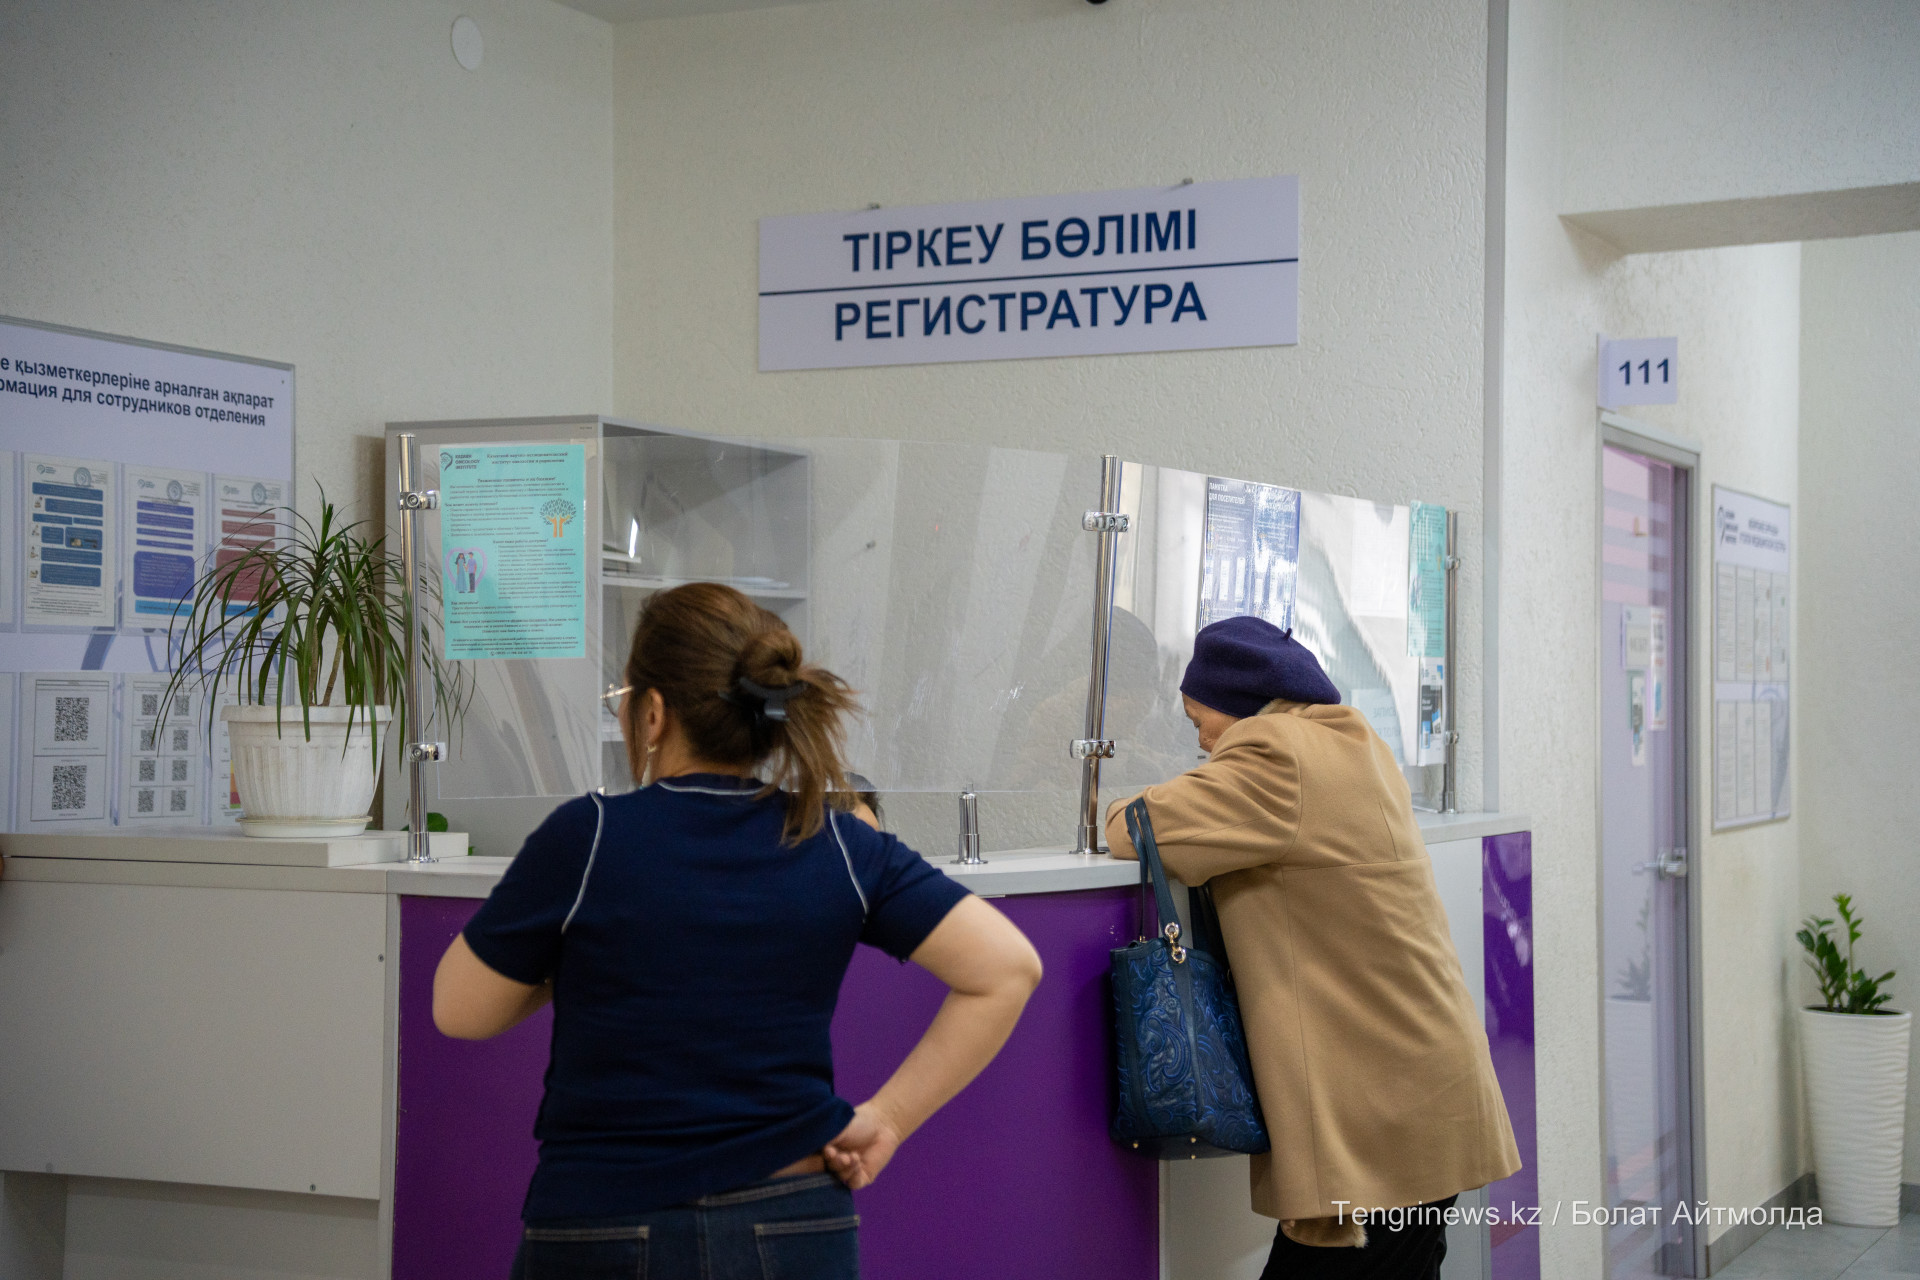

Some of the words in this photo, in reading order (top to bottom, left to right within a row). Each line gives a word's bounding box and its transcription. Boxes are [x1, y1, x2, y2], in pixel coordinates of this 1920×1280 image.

[843, 222, 1004, 272] ТІРКЕУ
[1021, 208, 1196, 260] БӨЛІМІ
[834, 280, 1208, 341] РЕГИСТРАТУРА
[15, 359, 150, 391] қызметкерлеріне
[154, 380, 219, 401] арналған
[223, 390, 274, 410] ақпарат
[1619, 357, 1669, 386] 111
[62, 387, 92, 403] для
[96, 392, 191, 416] сотрудников
[195, 405, 265, 426] отделения
